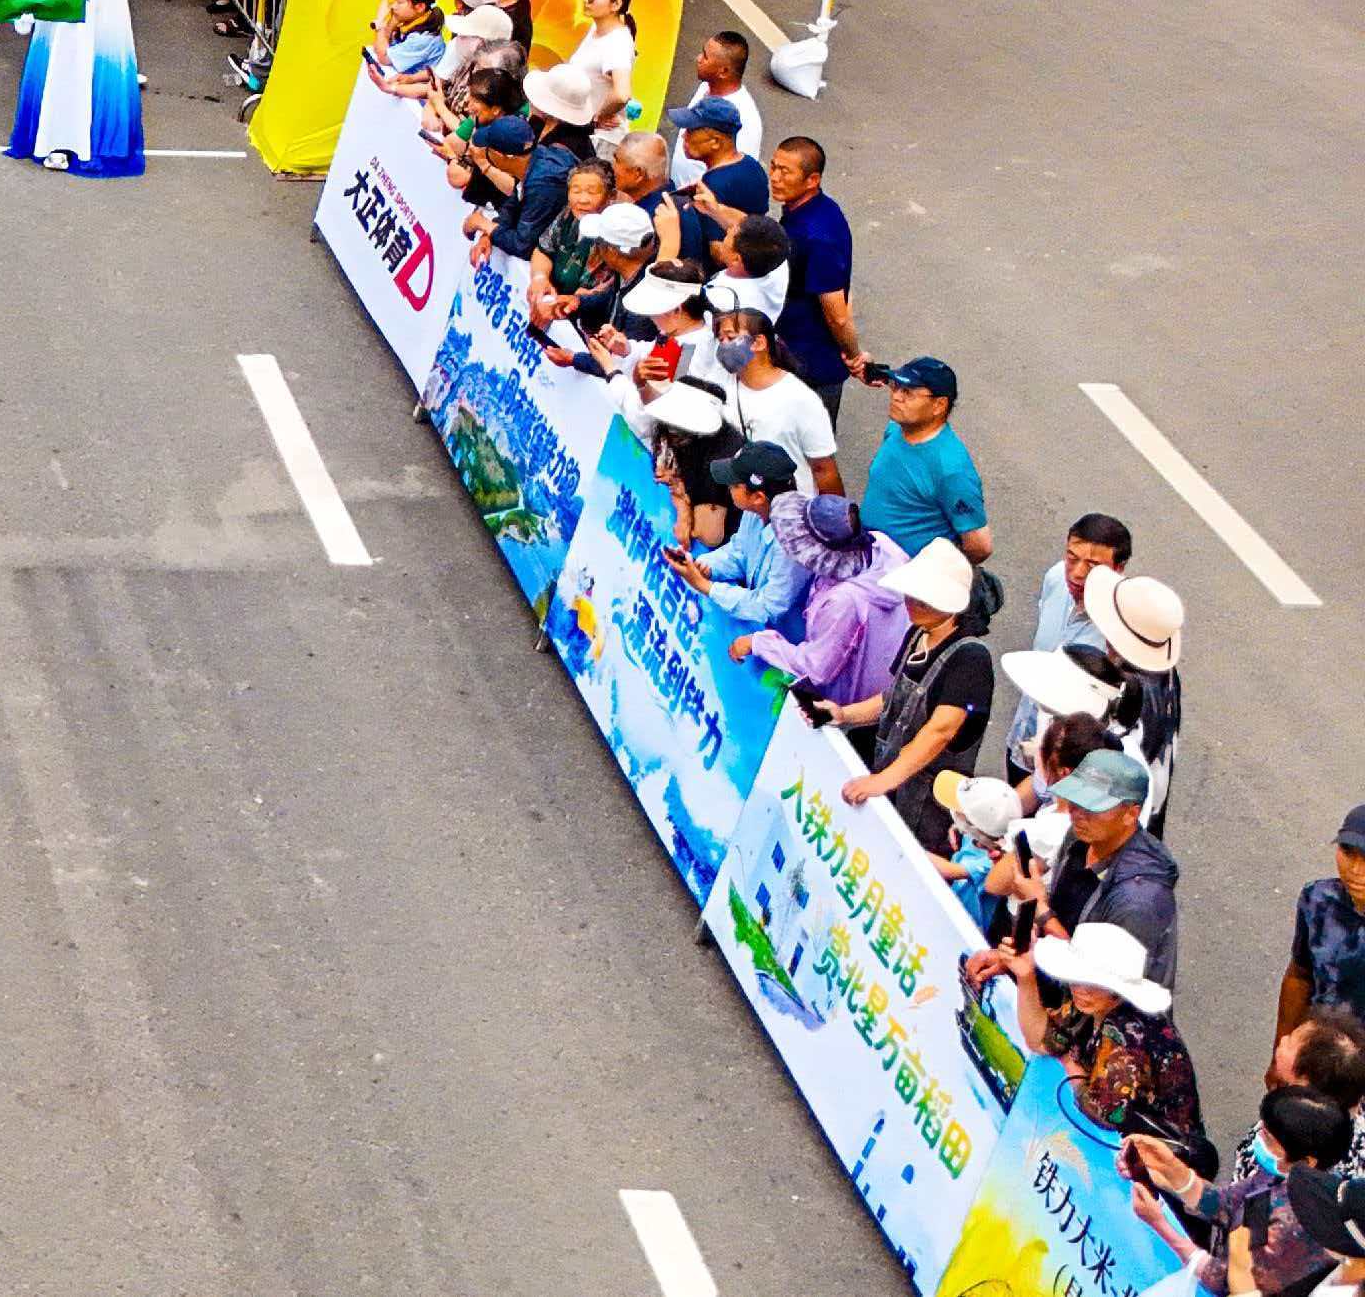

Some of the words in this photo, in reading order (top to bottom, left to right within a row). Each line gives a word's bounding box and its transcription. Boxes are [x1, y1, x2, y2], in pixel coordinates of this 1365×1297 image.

[344, 168, 414, 274] 大正体育
[377, 166, 398, 196] ZHENG
[394, 191, 417, 226] SPORTS
[626, 589, 723, 771] 漂流到铁力
[780, 764, 931, 999] 入铁力星月童话
[812, 909, 973, 1180] 赏北星万亩稻田
